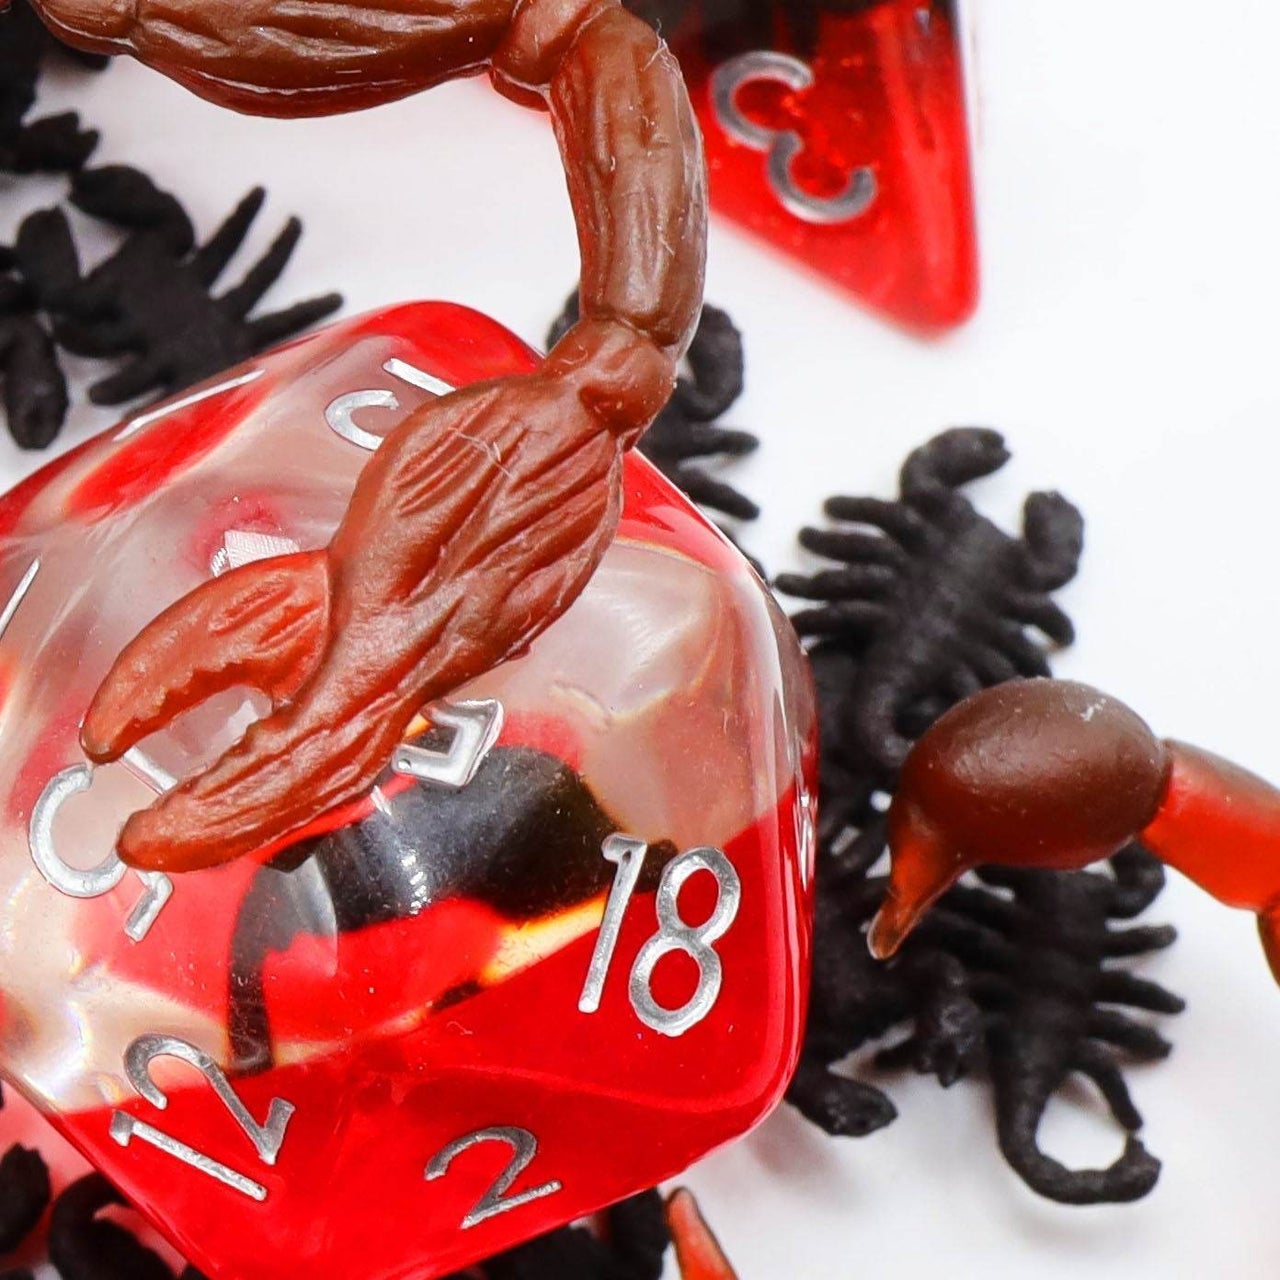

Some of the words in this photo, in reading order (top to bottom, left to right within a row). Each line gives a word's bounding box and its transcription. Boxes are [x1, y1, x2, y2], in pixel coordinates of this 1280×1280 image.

[709, 50, 878, 224] 3
[577, 834, 741, 1037] 18
[109, 1034, 297, 1201] 12
[424, 1126, 562, 1230] 2
